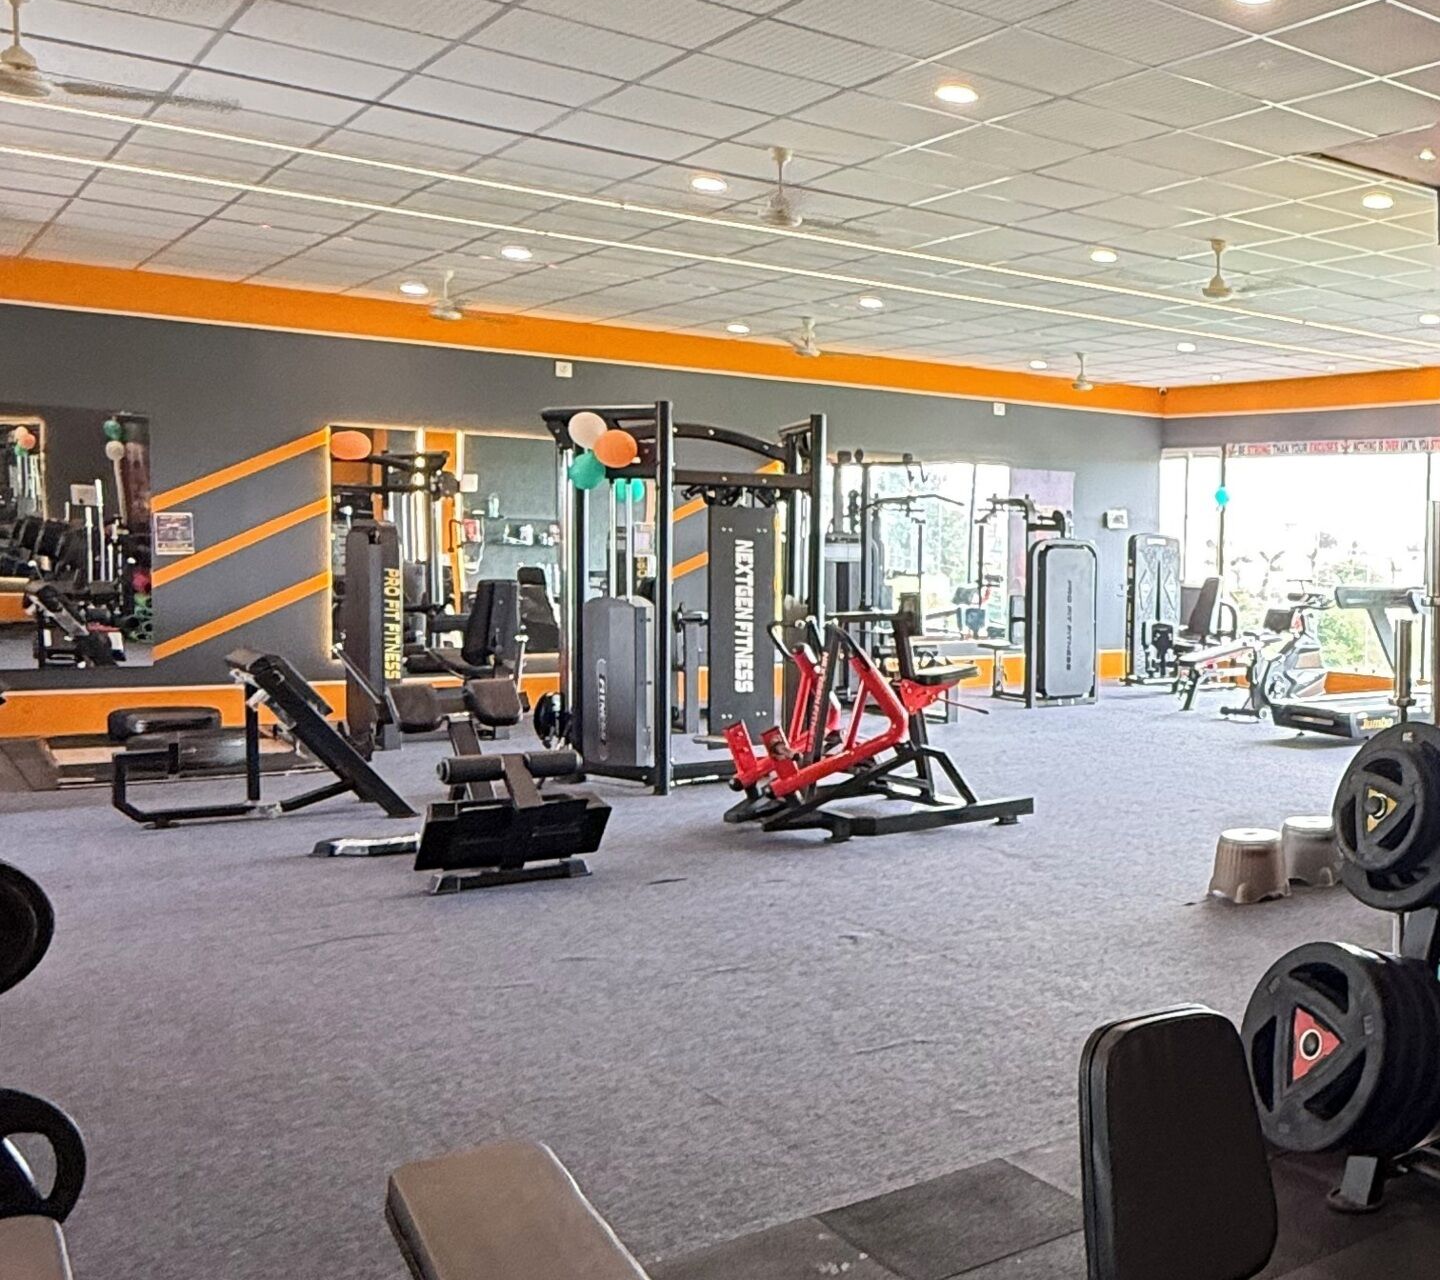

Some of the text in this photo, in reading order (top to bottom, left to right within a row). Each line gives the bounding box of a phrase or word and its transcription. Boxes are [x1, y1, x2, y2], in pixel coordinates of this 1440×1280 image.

[1272, 443, 1289, 455] THAN
[1291, 442, 1307, 454] YOUR
[384, 568, 401, 680] PRO FIT FITNESS
